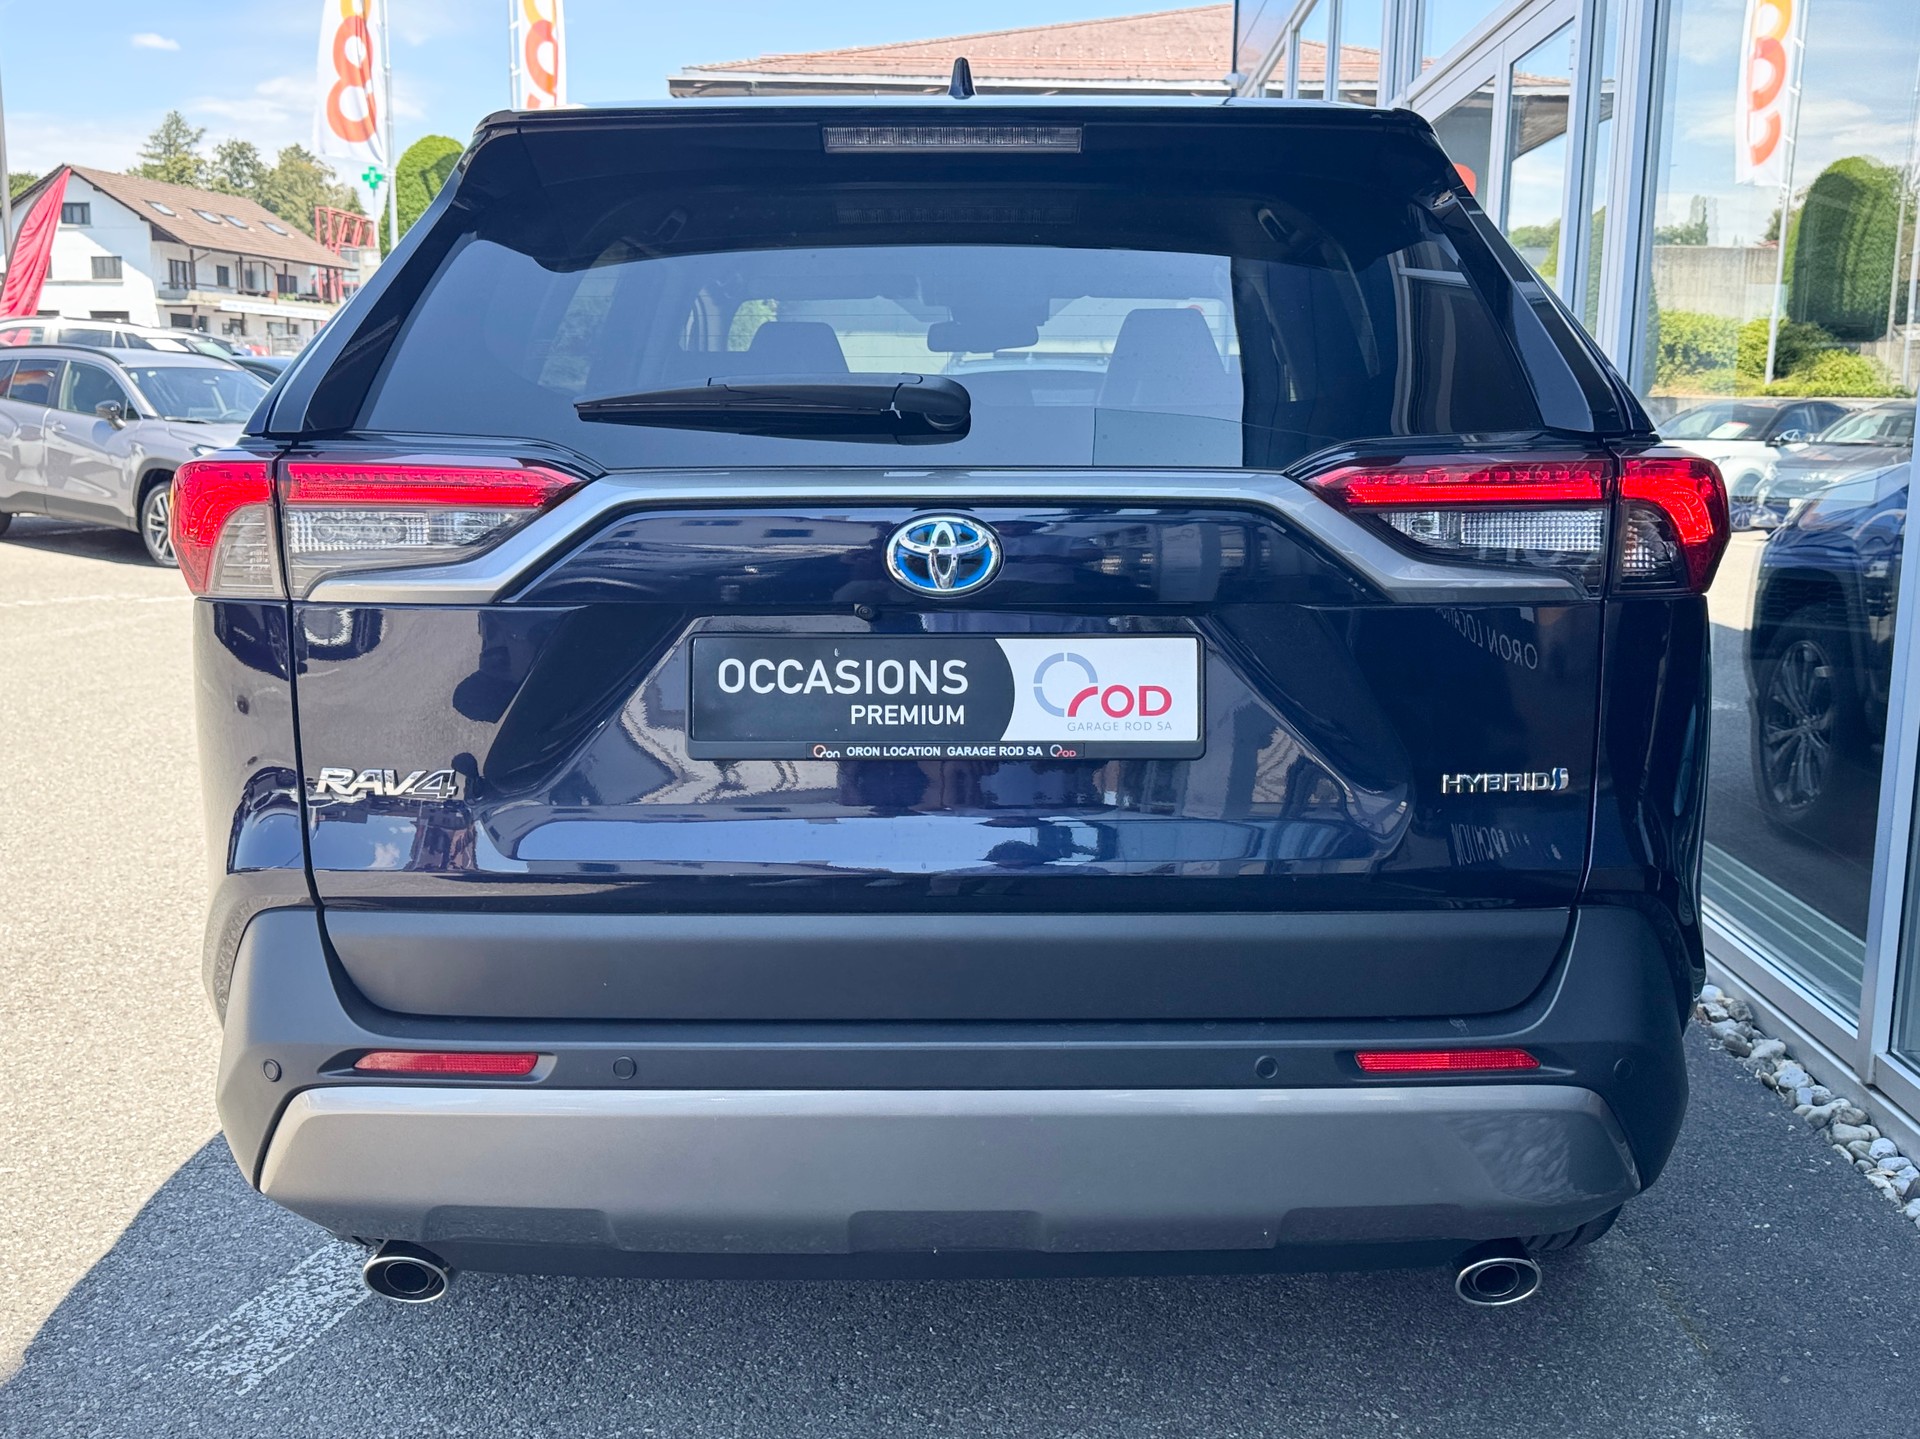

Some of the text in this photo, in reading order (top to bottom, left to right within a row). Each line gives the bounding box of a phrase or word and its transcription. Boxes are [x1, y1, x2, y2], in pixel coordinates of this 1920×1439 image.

[718, 658, 969, 695] OCCASIONS
[850, 705, 966, 725] PREMIUM
[1067, 721, 1172, 732] GARAGE ROD SA
[846, 746, 1043, 757] ORON LOCATION GARAGE ROD SA
[316, 767, 460, 798] RAV4
[1441, 771, 1551, 794] HYBRID
